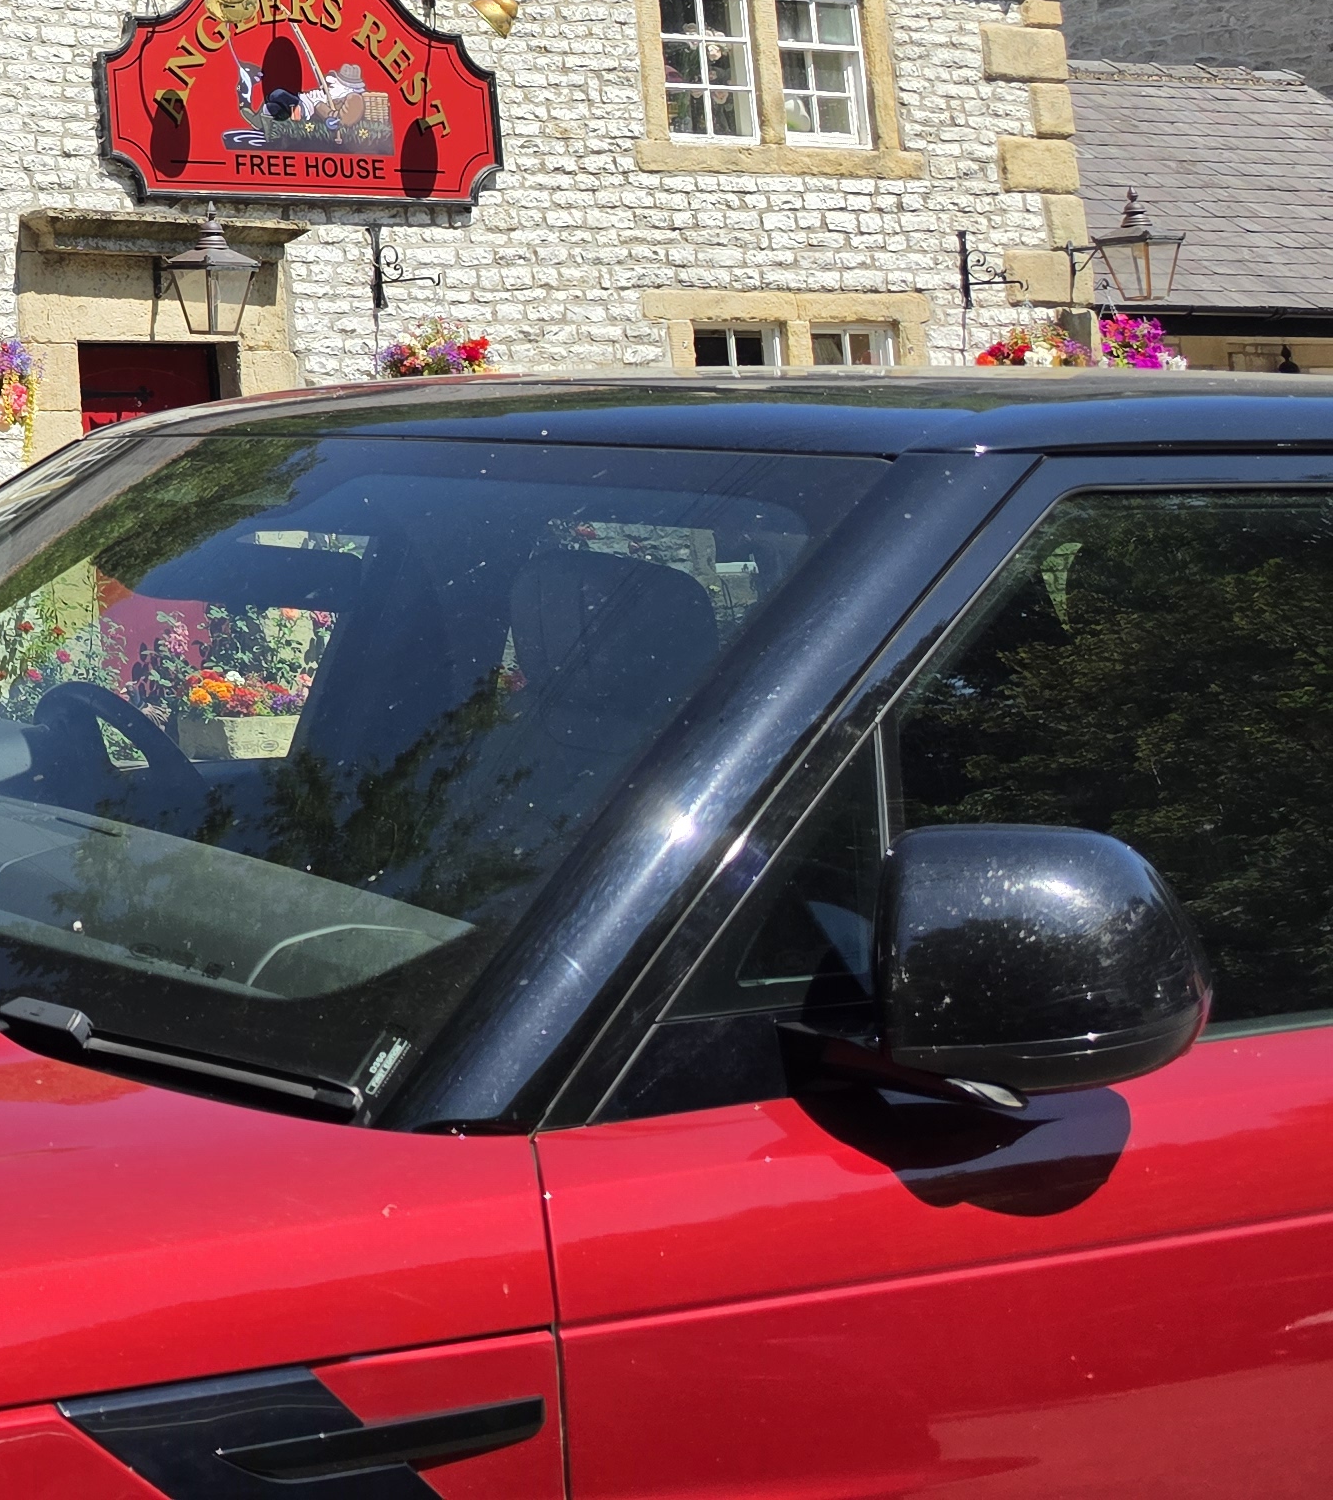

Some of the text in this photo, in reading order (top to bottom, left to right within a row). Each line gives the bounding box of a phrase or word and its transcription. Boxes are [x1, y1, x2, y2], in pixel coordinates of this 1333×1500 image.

[352, 10, 451, 139] REST
[235, 154, 386, 180] FREE HOUSE
